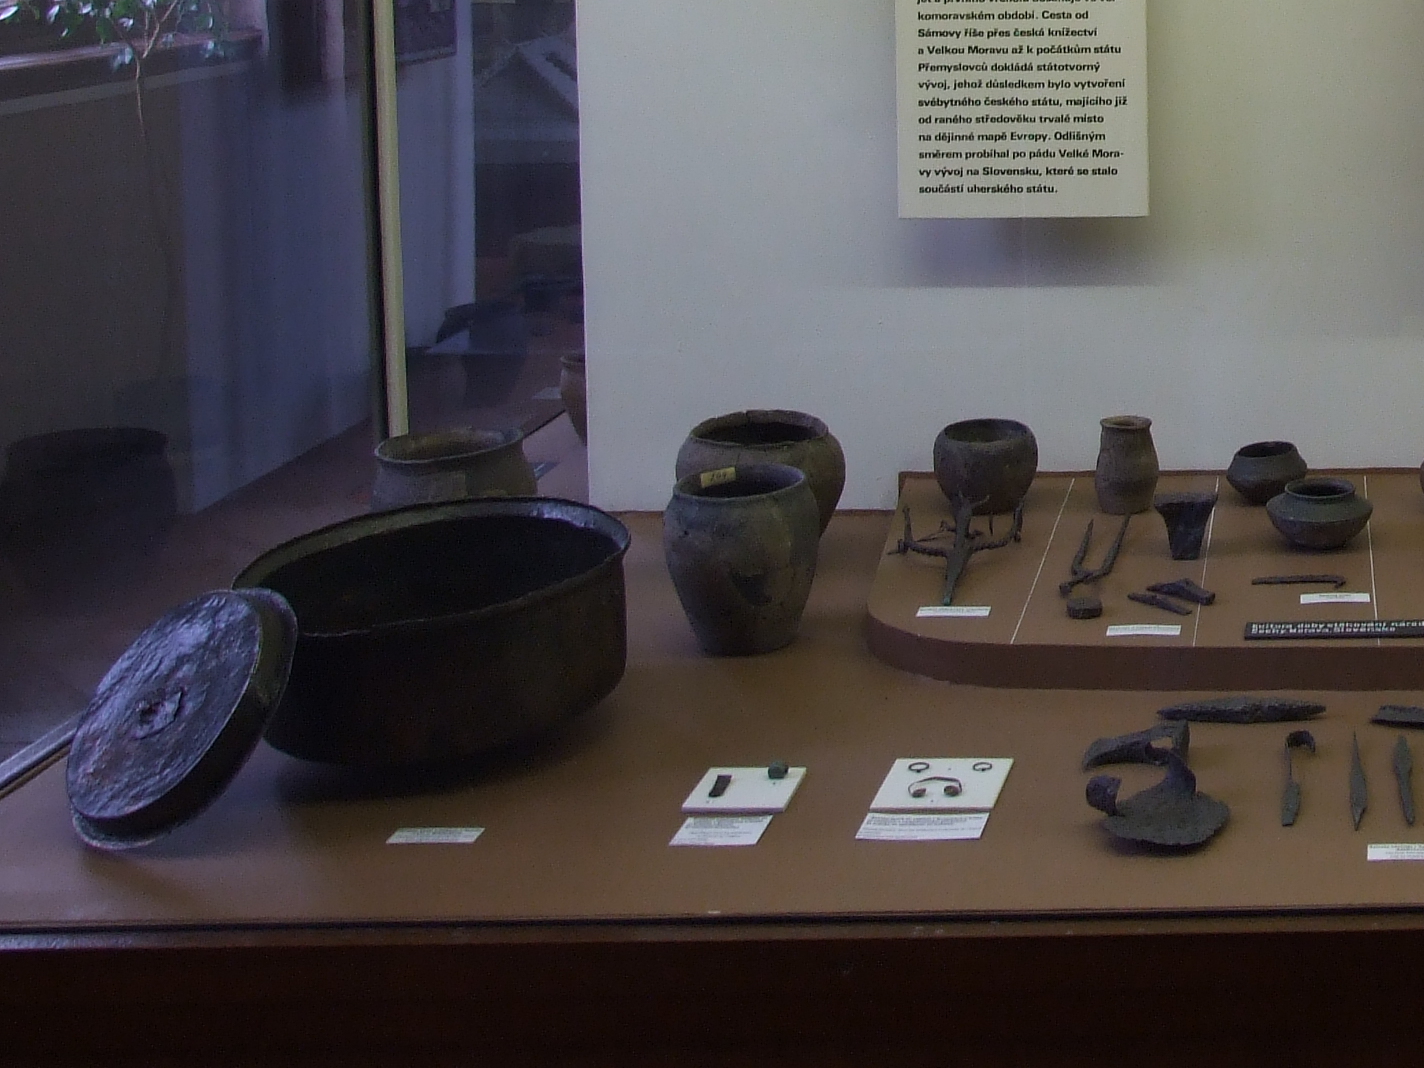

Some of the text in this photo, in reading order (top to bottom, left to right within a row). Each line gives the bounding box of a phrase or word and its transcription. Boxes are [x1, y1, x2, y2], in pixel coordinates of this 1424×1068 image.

[918, 10, 1088, 21] komoravském období. Cesta od
[918, 27, 1097, 39] Sámovy říše přes česká knížectví
[927, 45, 965, 55] Velkou
[968, 45, 1008, 54] Moravu
[1011, 45, 1023, 54] až
[1027, 45, 1034, 54] k
[1036, 44, 1091, 56] počátkům
[1094, 44, 1121, 54] státu
[918, 62, 1100, 73] Přemyslovců dokládá státotvorný
[918, 78, 1125, 91] vývoj, jehož důsledkem bylo vytvoření
[918, 96, 1128, 109] svébytného českého státu, majícího již
[918, 113, 1104, 124] od raného středověku trvalé místo
[935, 132, 974, 143] dějinné
[977, 132, 1007, 143] mapě
[1010, 131, 1051, 142] Evropy.
[1054, 131, 1105, 142] Odlišným
[919, 149, 1124, 160] směrem probíhal po pádu Velké Mora-
[919, 169, 932, 178] vy
[934, 166, 963, 178] vývoj
[982, 167, 1042, 176] Slovensku,
[1046, 166, 1074, 176] které
[1091, 166, 1118, 176] stalo
[919, 181, 1058, 193] součástí uherského státu.
